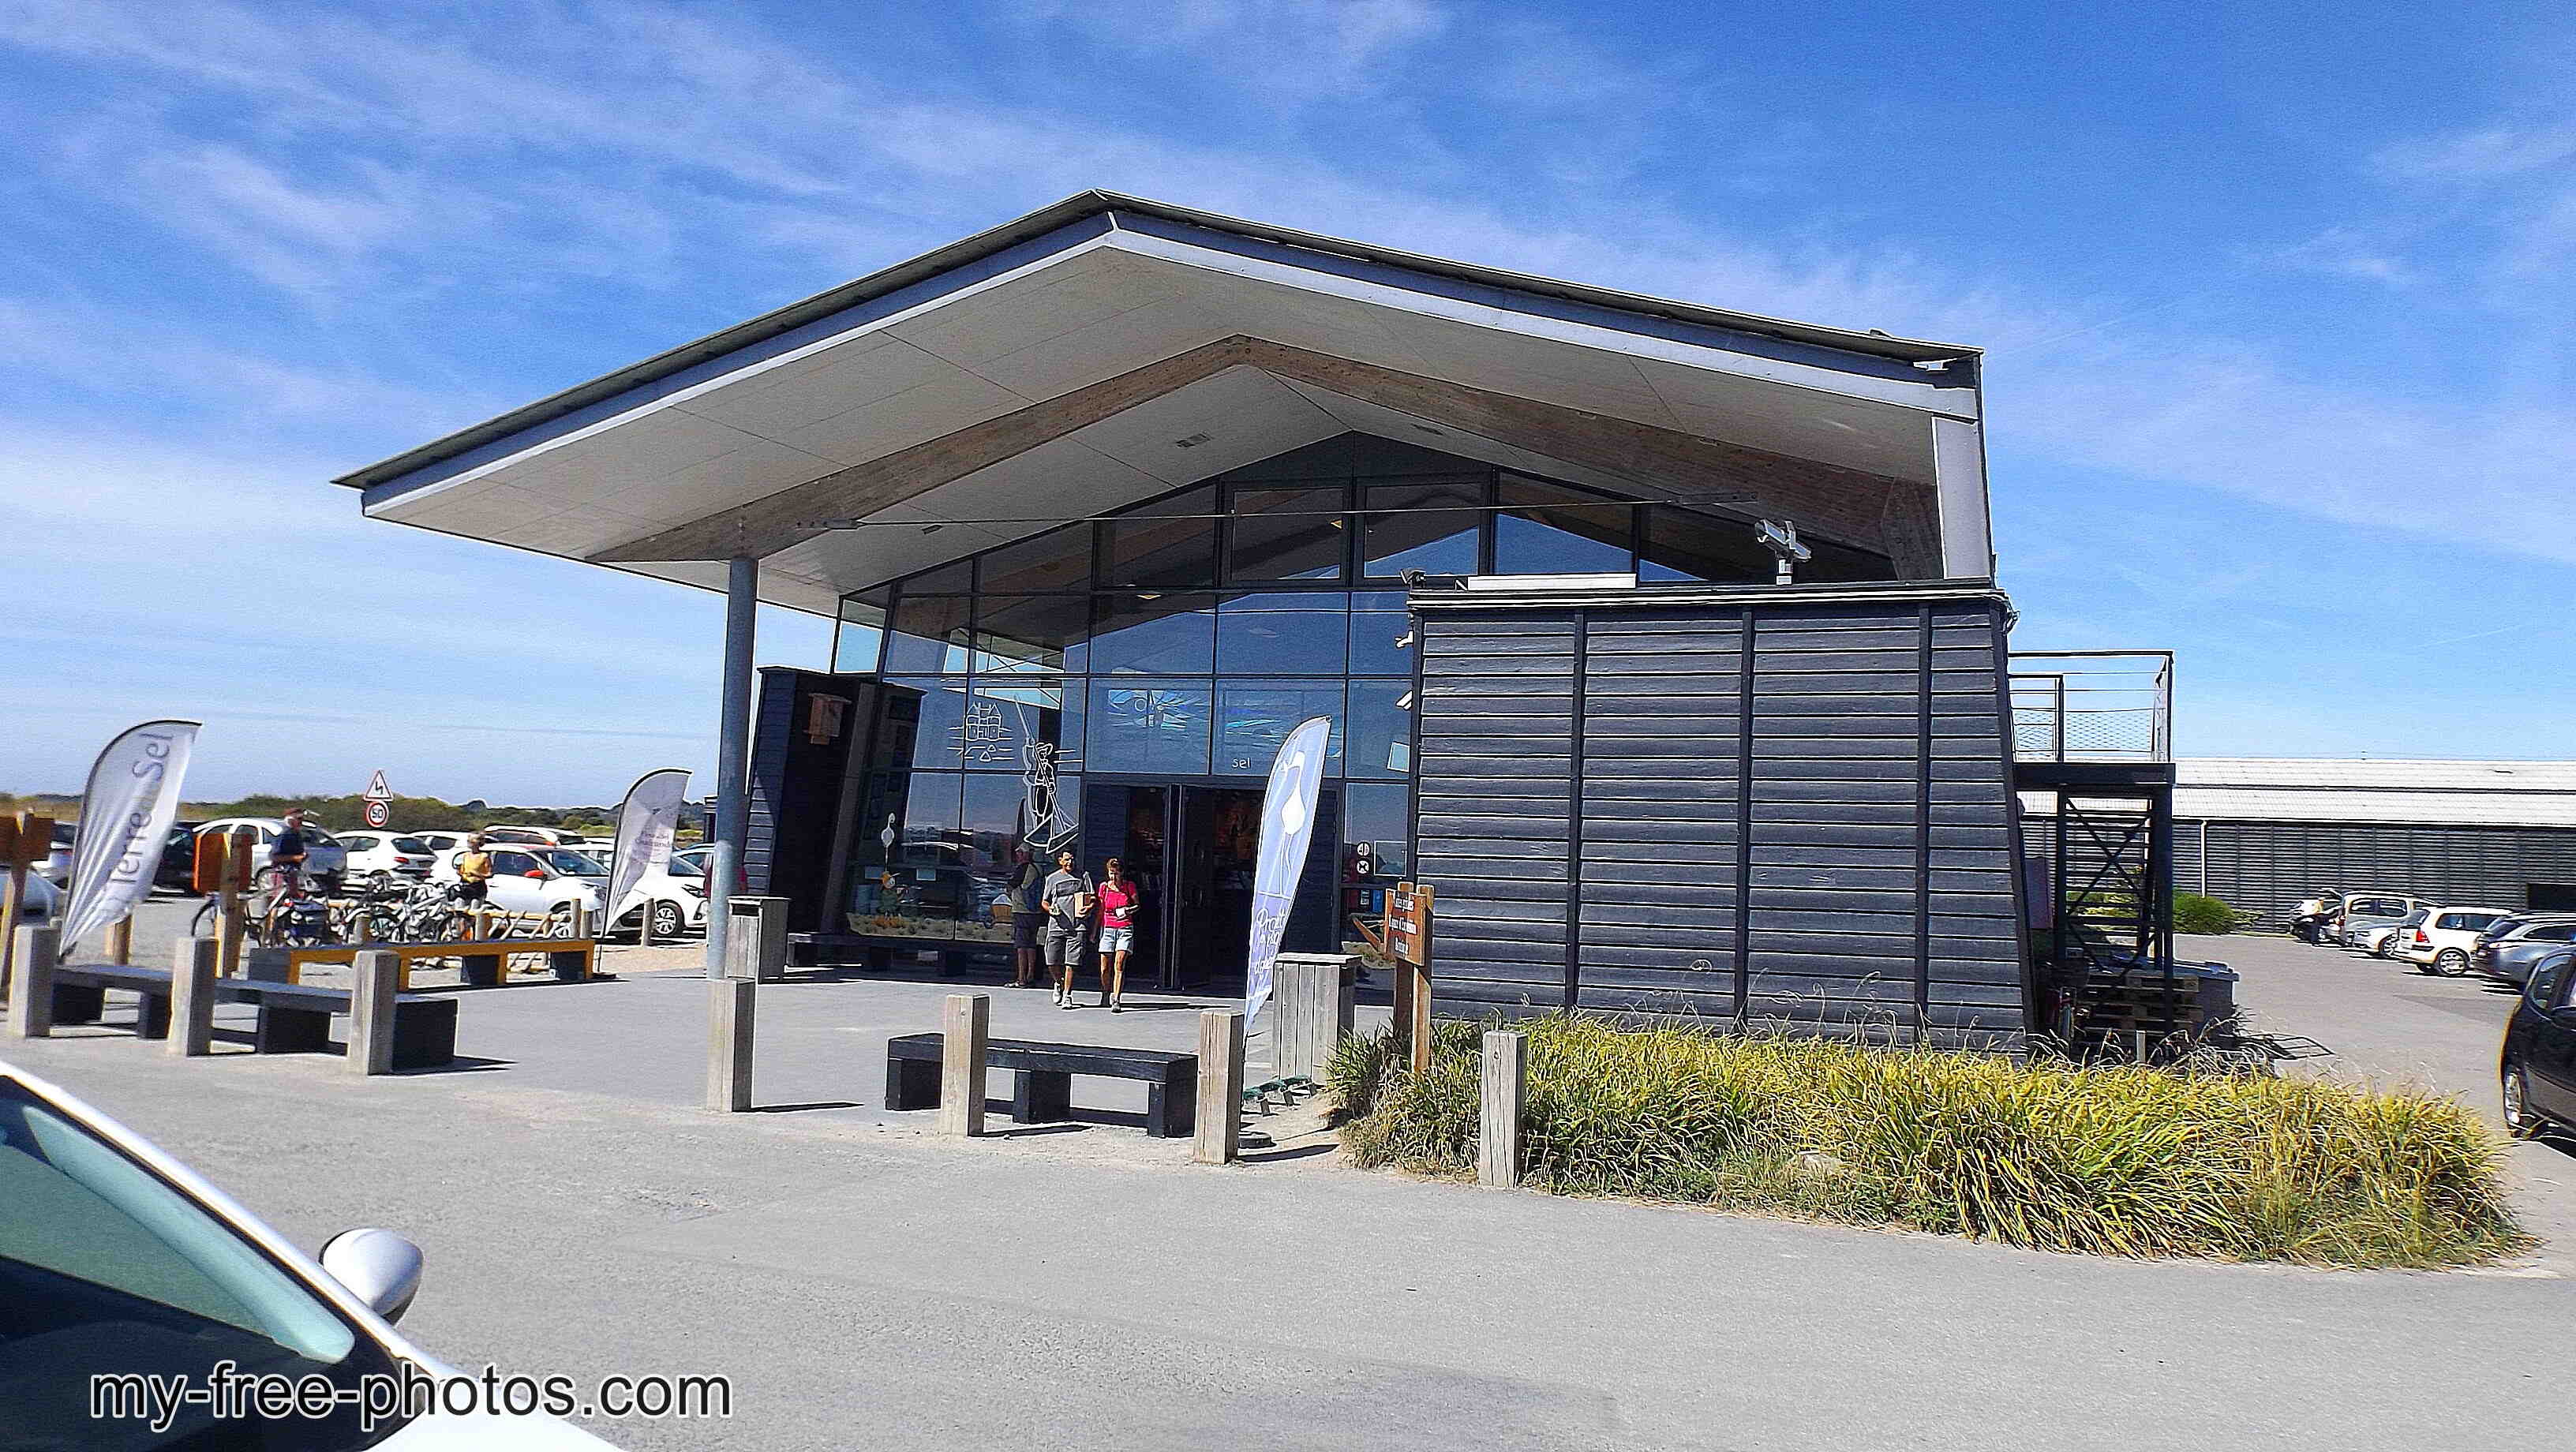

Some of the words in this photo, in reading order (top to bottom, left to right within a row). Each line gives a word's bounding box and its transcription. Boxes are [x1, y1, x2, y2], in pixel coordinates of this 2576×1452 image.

[132, 732, 174, 780] Sel
[1231, 757, 1251, 769] sel
[372, 808, 384, 819] 50
